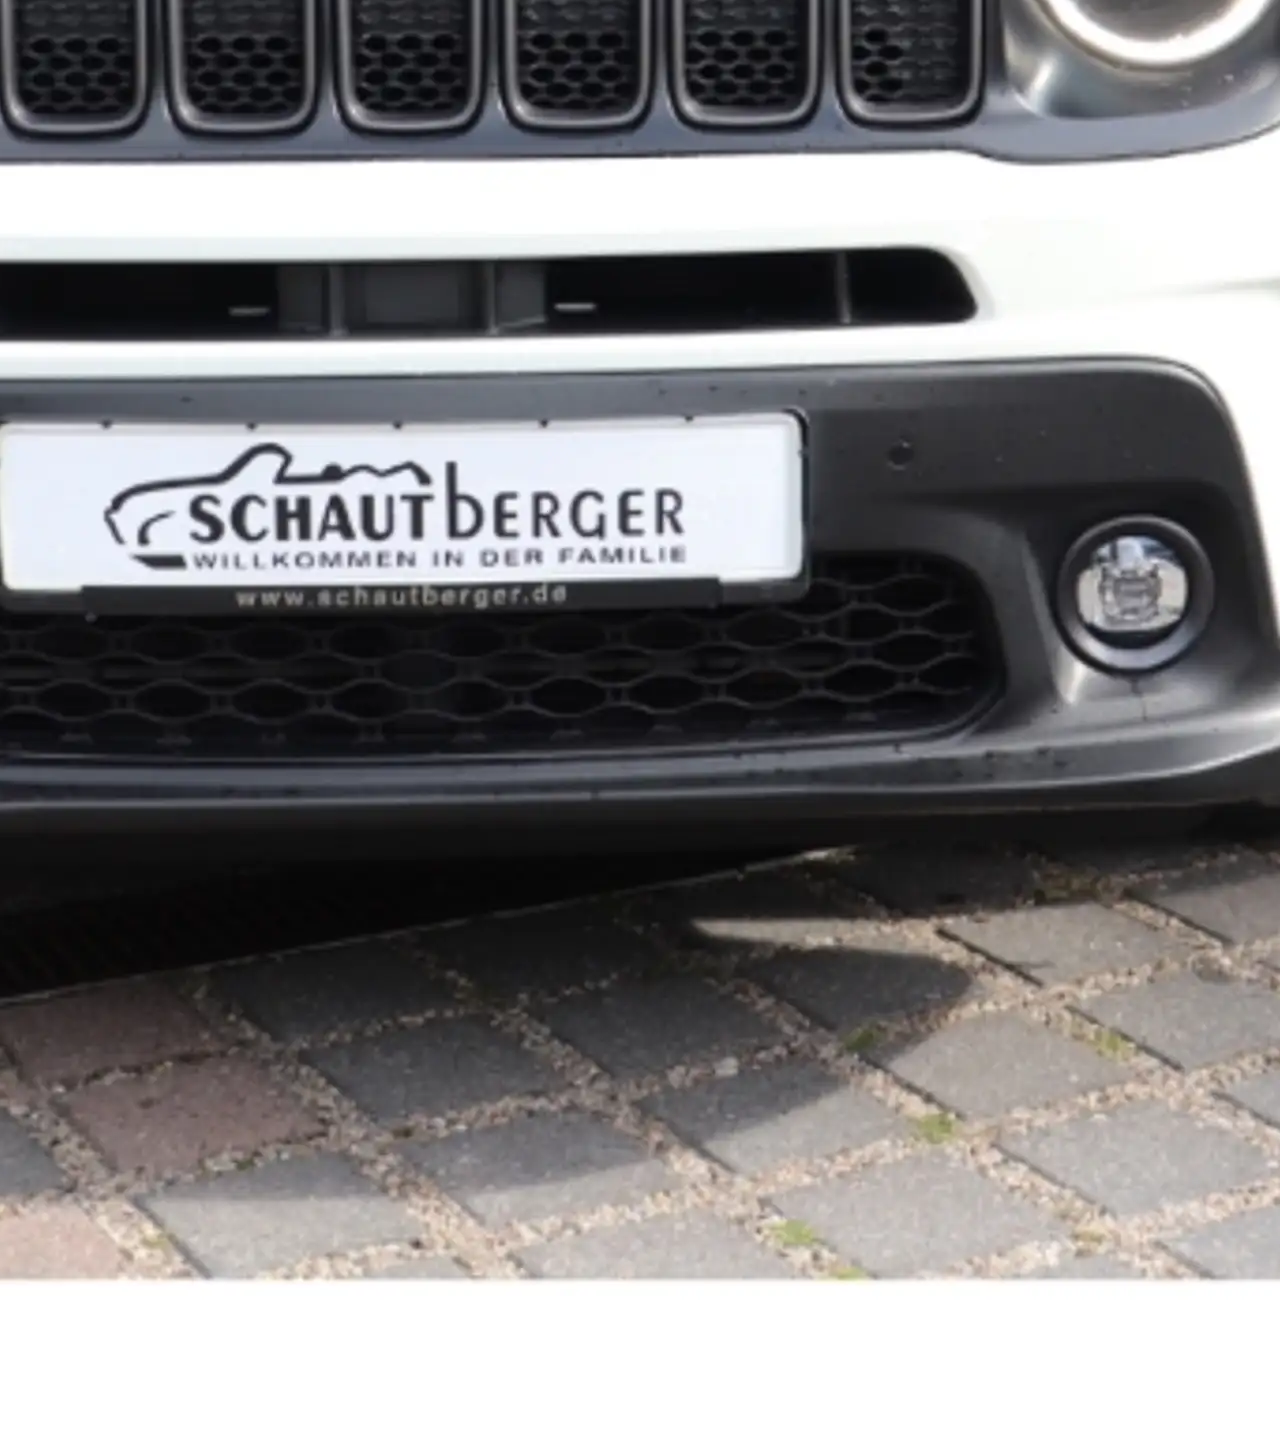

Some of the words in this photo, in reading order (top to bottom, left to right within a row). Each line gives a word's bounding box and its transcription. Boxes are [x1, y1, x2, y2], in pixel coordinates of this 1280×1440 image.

[192, 550, 417, 570] WILLKOMMEN
[432, 548, 465, 567] IN
[479, 547, 545, 568] DER
[557, 544, 687, 565] FAMILIE
[234, 583, 569, 609] www.schautberger.de
